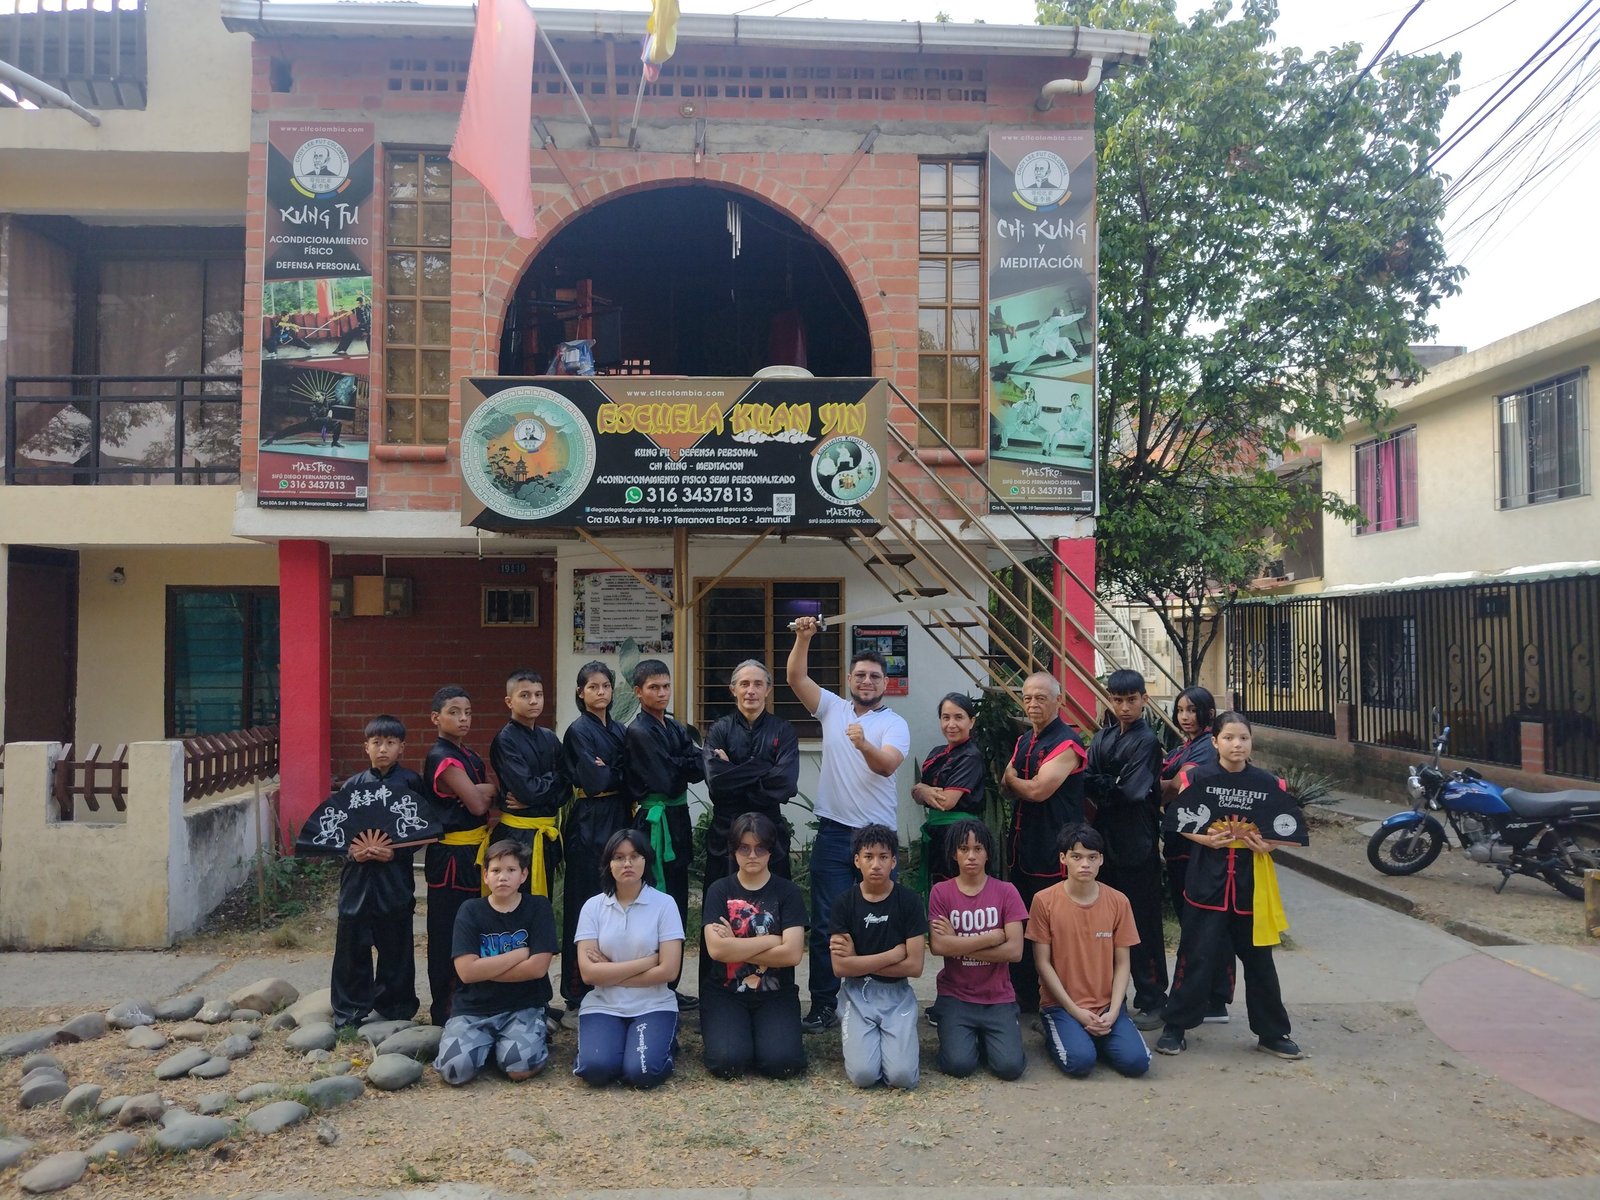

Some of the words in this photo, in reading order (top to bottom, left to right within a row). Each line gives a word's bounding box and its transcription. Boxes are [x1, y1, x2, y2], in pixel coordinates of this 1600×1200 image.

[280, 205, 330, 229] KUNG
[335, 203, 359, 230] FU
[1033, 218, 1087, 245] KUNG
[269, 235, 369, 246] ACONDICIONAMIENTO
[304, 245, 333, 256] FÍSICO
[276, 261, 314, 270] DEFENSA
[316, 262, 361, 272] PERSONAL
[1000, 254, 1083, 269] MEDITACIÓN
[627, 389, 725, 397] www.clfcolombia.com
[597, 402, 724, 436] ESCUELA
[729, 402, 812, 435] KUAN
[818, 402, 867, 436] YIN
[634, 448, 658, 457] KUNG
[659, 448, 671, 457] FU
[679, 448, 716, 457] DEFENSA
[717, 448, 758, 457] PERSONAL
[292, 461, 336, 474] MAESTRO:
[649, 462, 662, 471] CHI
[664, 462, 688, 471] KUNG
[696, 462, 744, 471] MEDITACION
[290, 480, 306, 489] 316
[308, 480, 346, 490] 3437813
[596, 475, 680, 485] ACONDICIONAMIENTO
[681, 475, 708, 485] FISICO
[709, 475, 730, 485] SEMI
[731, 475, 796, 485] PERSONALIZADO
[646, 487, 678, 502] 316
[681, 487, 754, 502] 3437813
[1020, 486, 1036, 495] 316
[1037, 486, 1073, 495] 3437813
[826, 507, 865, 517] MAESTRO:
[586, 516, 602, 524] Cra
[604, 516, 621, 524] 50A
[622, 516, 635, 524] Sur
[637, 516, 643, 524] #
[645, 516, 673, 524] 19B-19
[674, 516, 715, 524] Terranova
[716, 516, 741, 525] Etapa
[742, 516, 748, 524] 2
[755, 515, 791, 524] Jamundí
[1205, 786, 1232, 796] CHOY
[1232, 788, 1249, 797] LEE
[1249, 790, 1269, 801] FUT
[1219, 795, 1242, 803] KUNG
[1218, 799, 1252, 810] Colombia
[950, 906, 998, 931] GOOD
